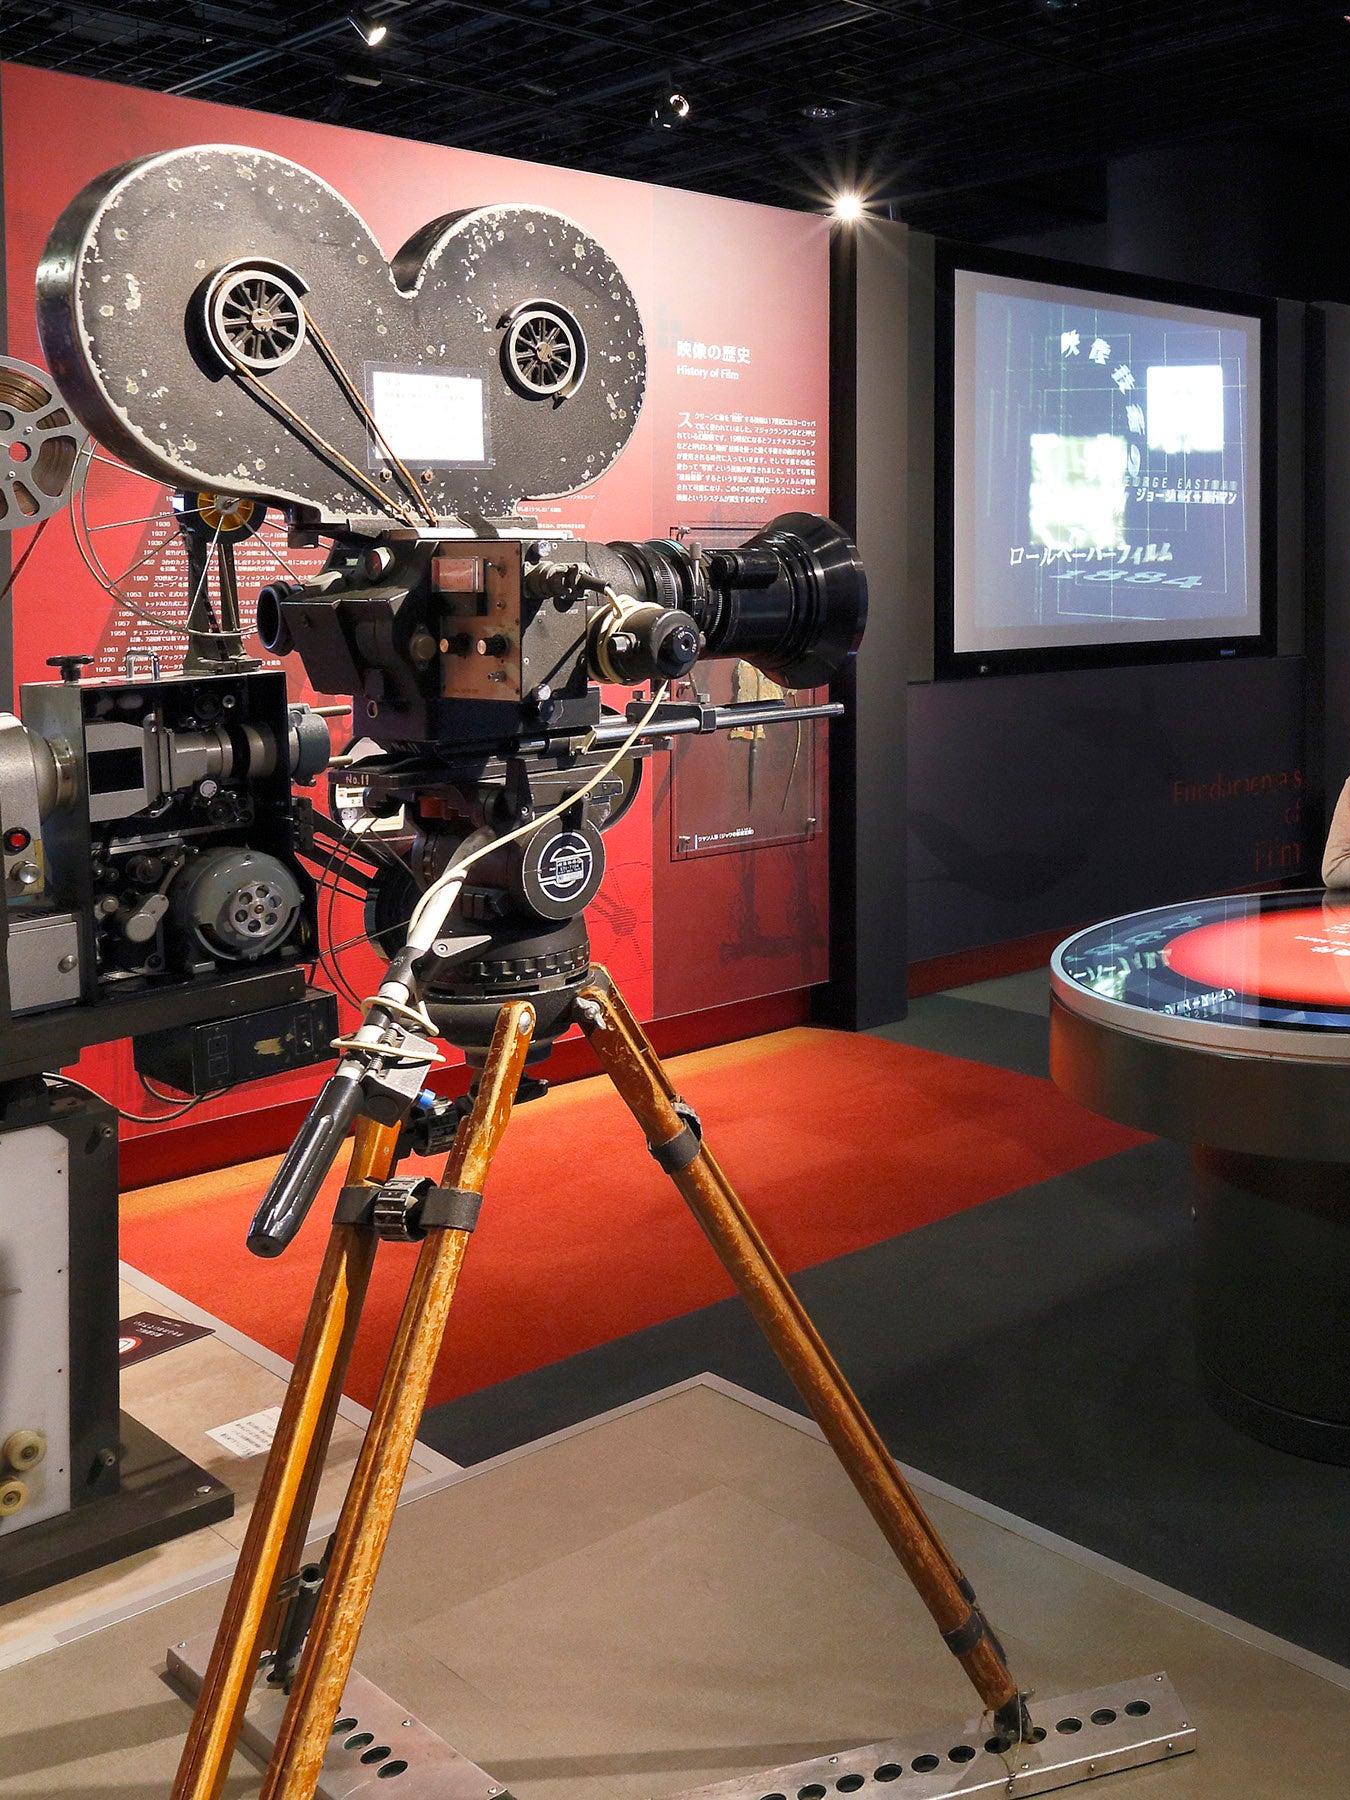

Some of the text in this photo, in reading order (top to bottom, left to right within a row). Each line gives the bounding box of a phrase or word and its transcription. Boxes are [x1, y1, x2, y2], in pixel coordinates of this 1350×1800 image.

[676, 340, 751, 364] 映像の歴史
[676, 365, 740, 380] History of Film
